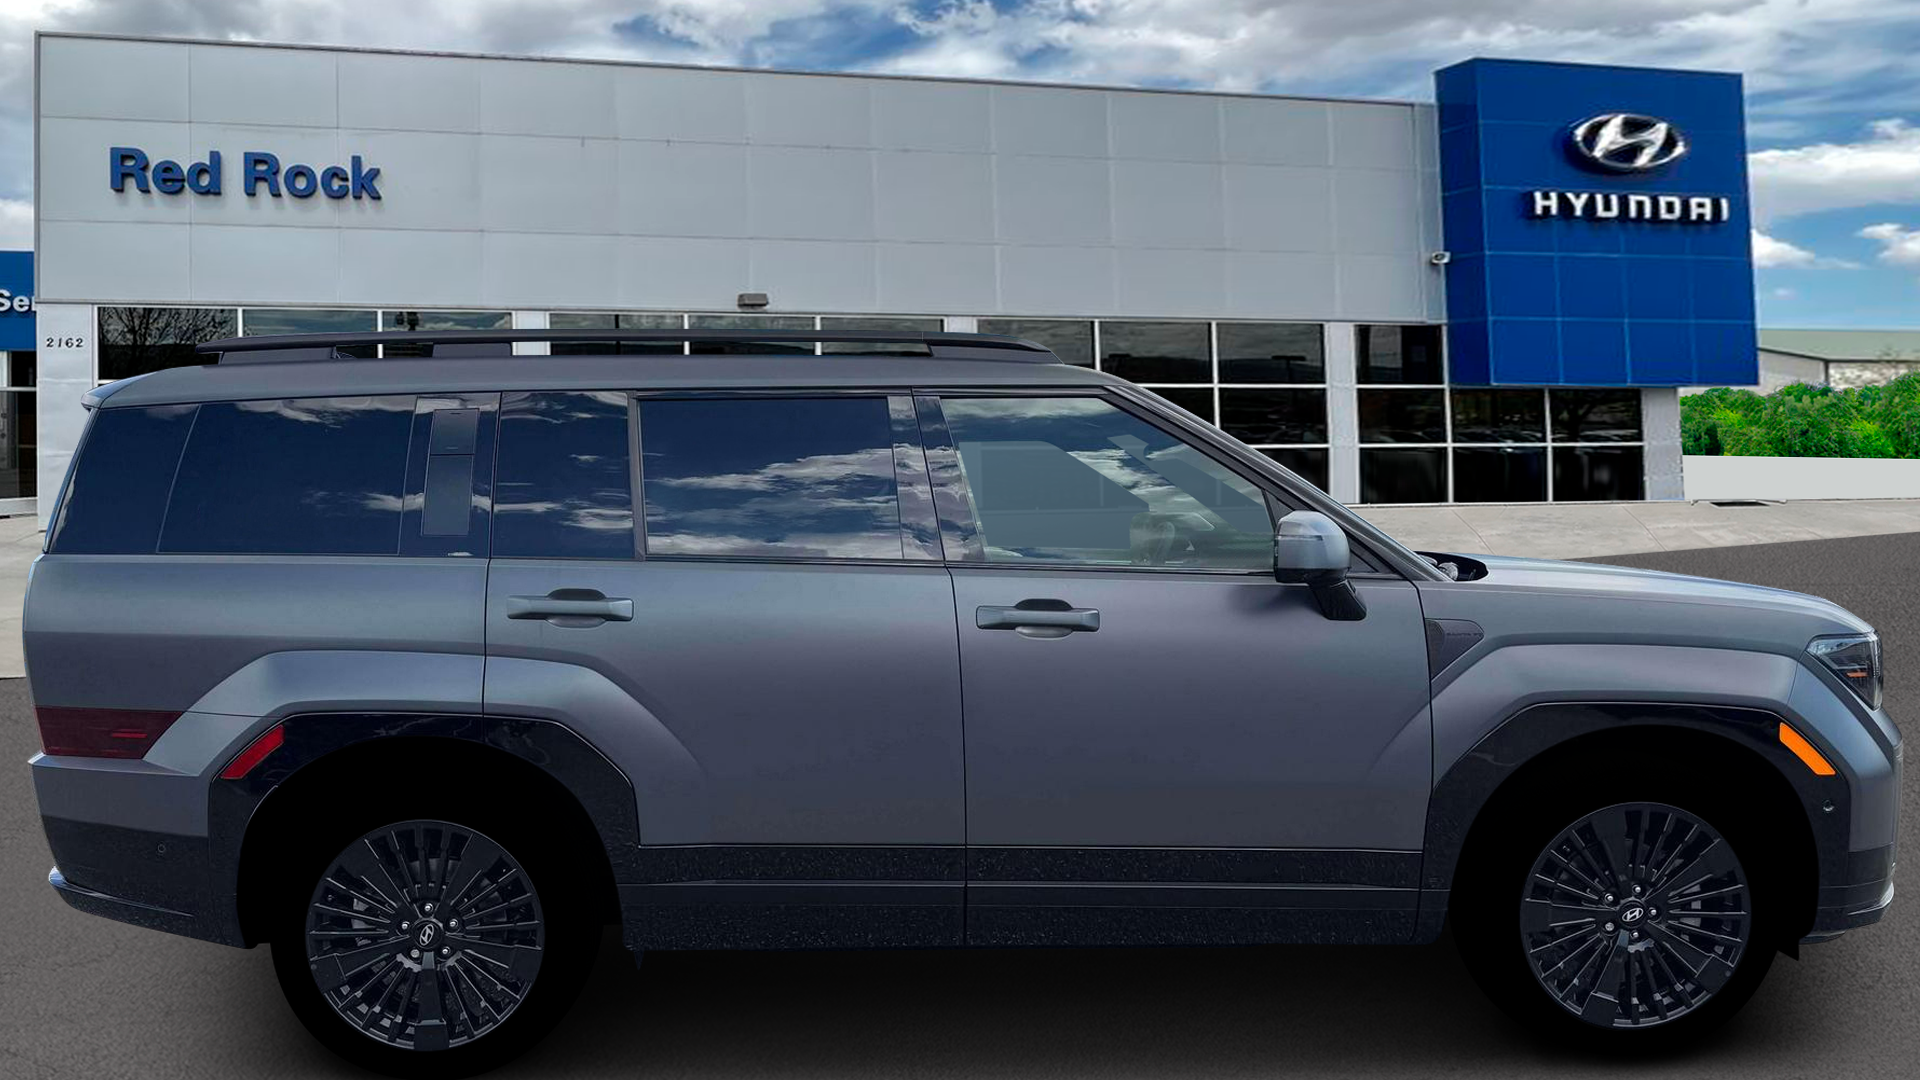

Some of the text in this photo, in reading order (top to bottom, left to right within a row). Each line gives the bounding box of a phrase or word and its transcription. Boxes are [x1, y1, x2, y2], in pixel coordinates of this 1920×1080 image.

[110, 147, 382, 200] Red Rock
[1533, 190, 1730, 222] HYUNDAI
[46, 337, 84, 349] 2162
